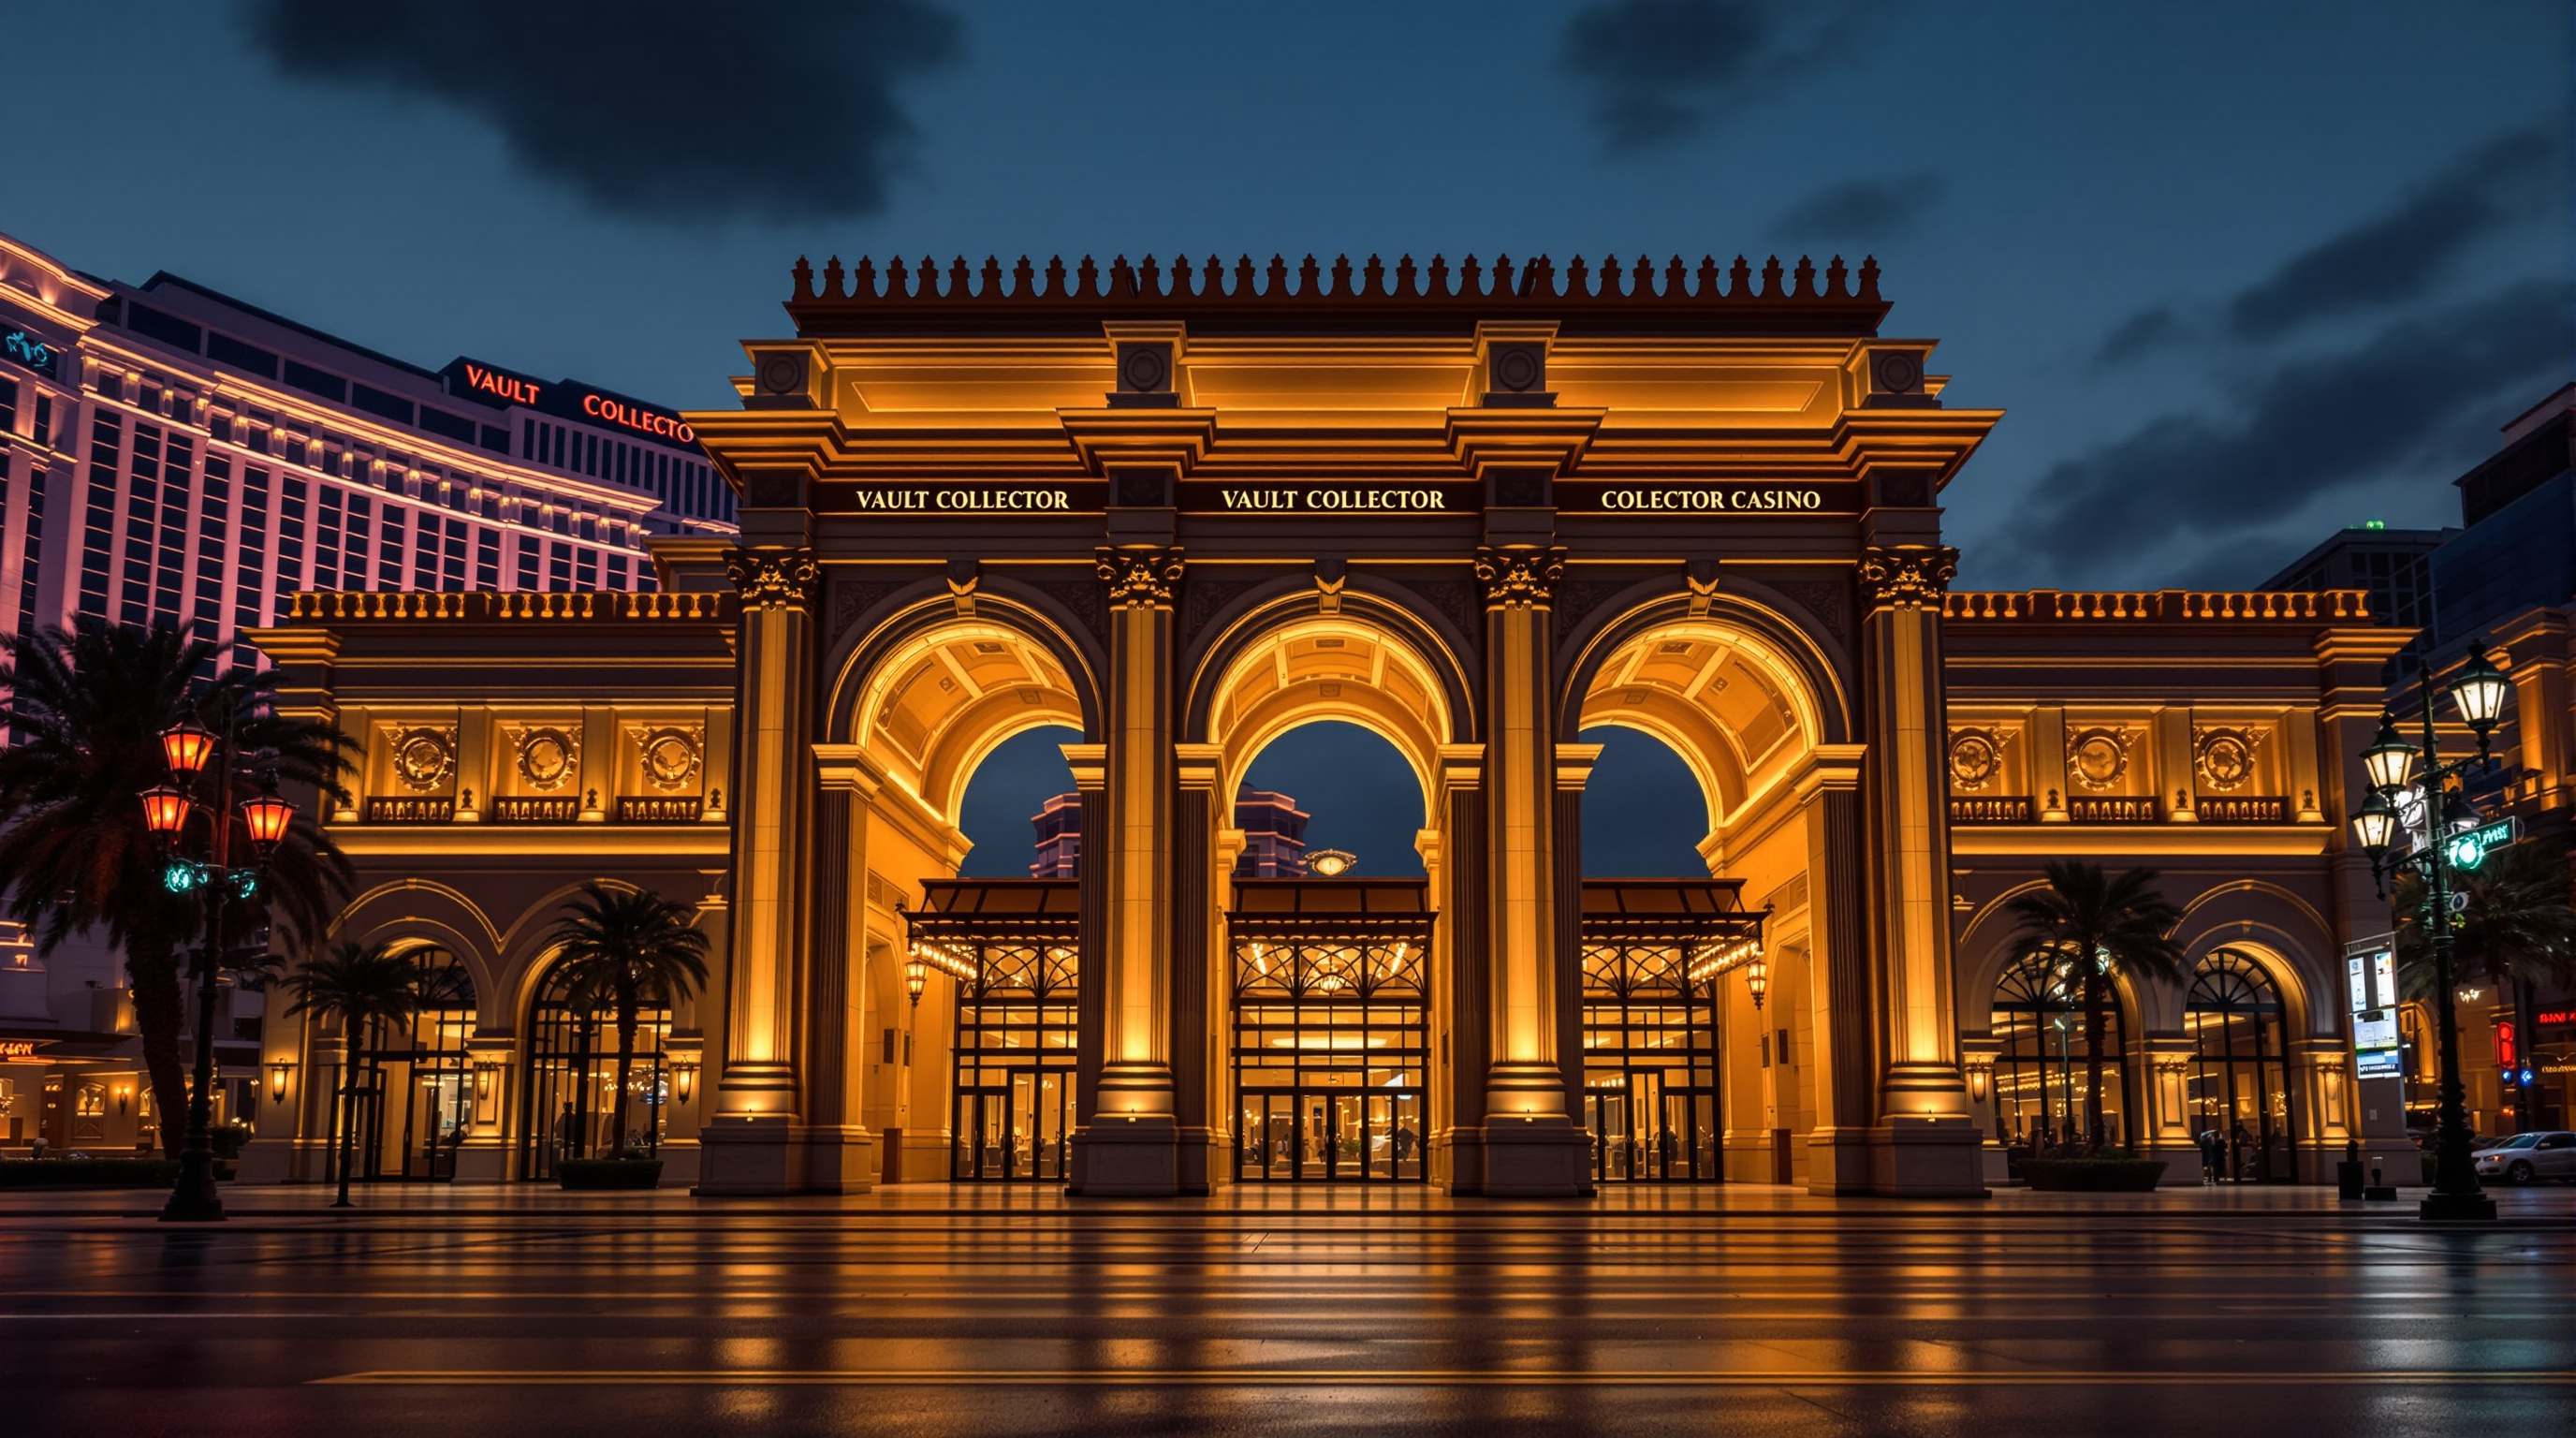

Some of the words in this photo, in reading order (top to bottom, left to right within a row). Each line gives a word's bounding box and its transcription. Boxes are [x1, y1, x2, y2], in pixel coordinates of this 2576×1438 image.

[465, 364, 540, 404] VAULT
[856, 491, 929, 508] VAULT
[936, 491, 1070, 509] COLLECTOR
[1222, 490, 1298, 508] VAULT
[1306, 490, 1445, 508] COLLECTOR
[1602, 491, 1725, 508] COLECTOR
[1731, 491, 1821, 508] CASINO
